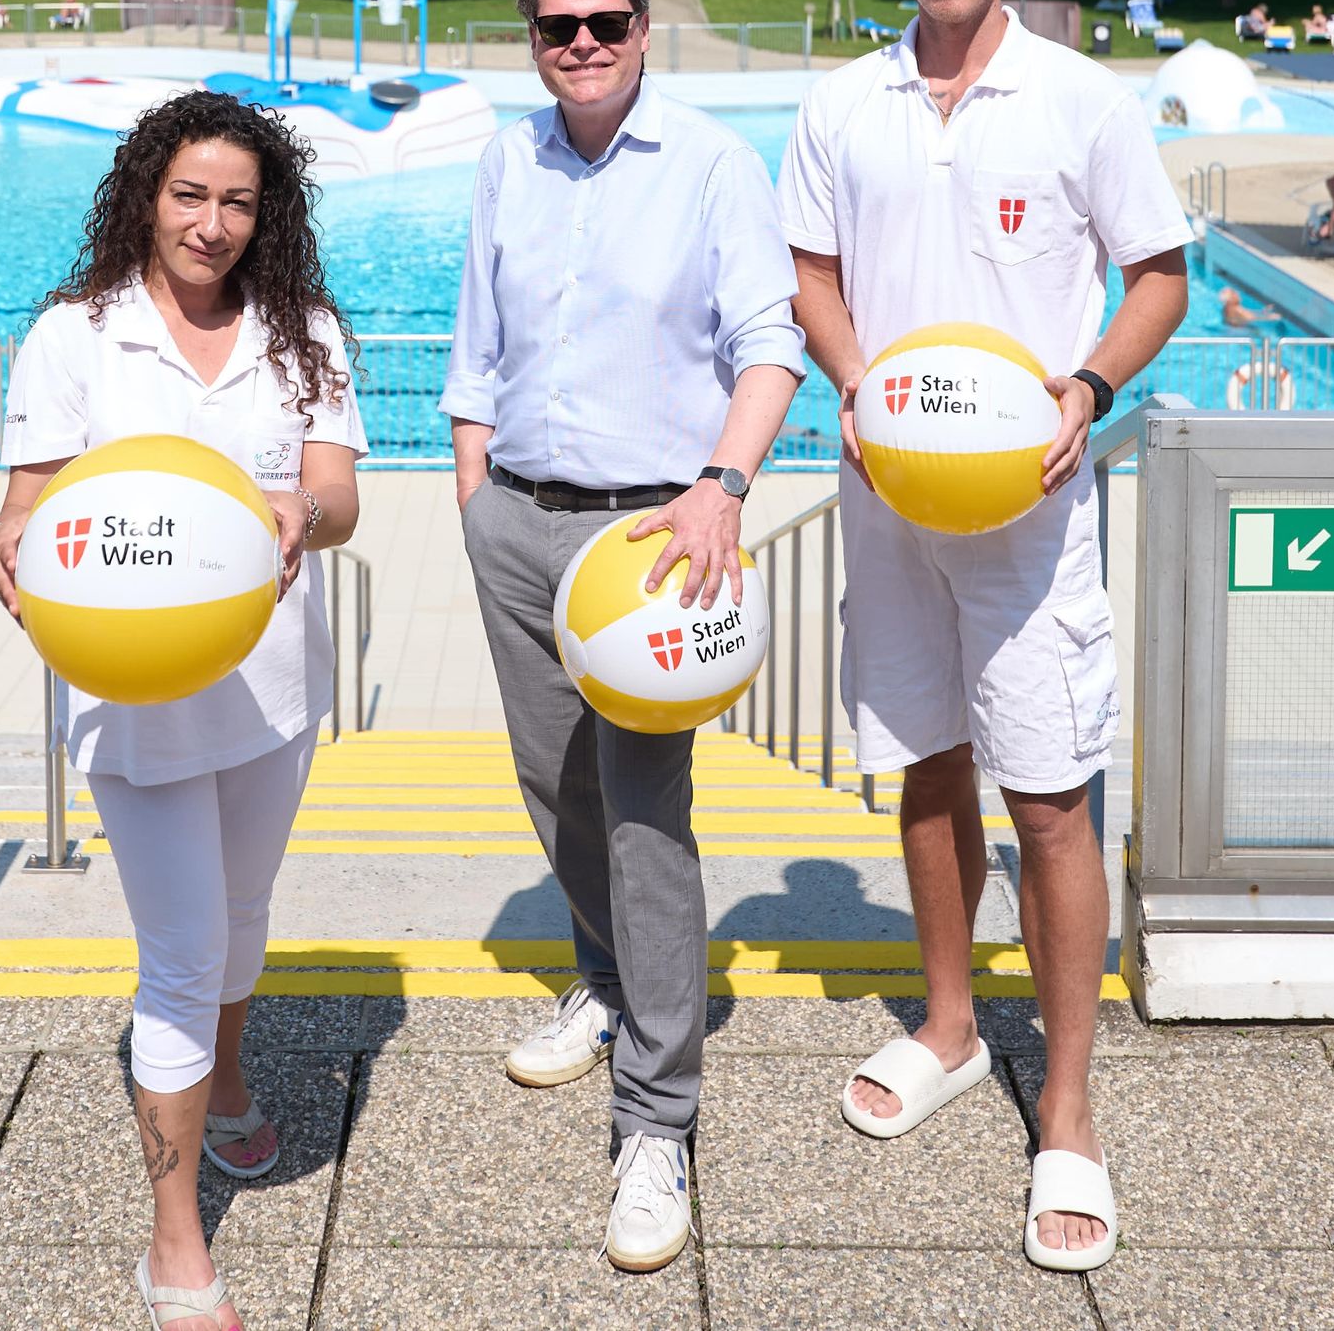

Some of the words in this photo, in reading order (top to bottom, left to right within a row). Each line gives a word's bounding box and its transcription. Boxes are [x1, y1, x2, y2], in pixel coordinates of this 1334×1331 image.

[920, 395, 977, 415] Wien
[102, 515, 176, 538] Stadt
[101, 542, 174, 568] Wien
[692, 609, 742, 643] Stadt
[695, 635, 746, 664] Wien
